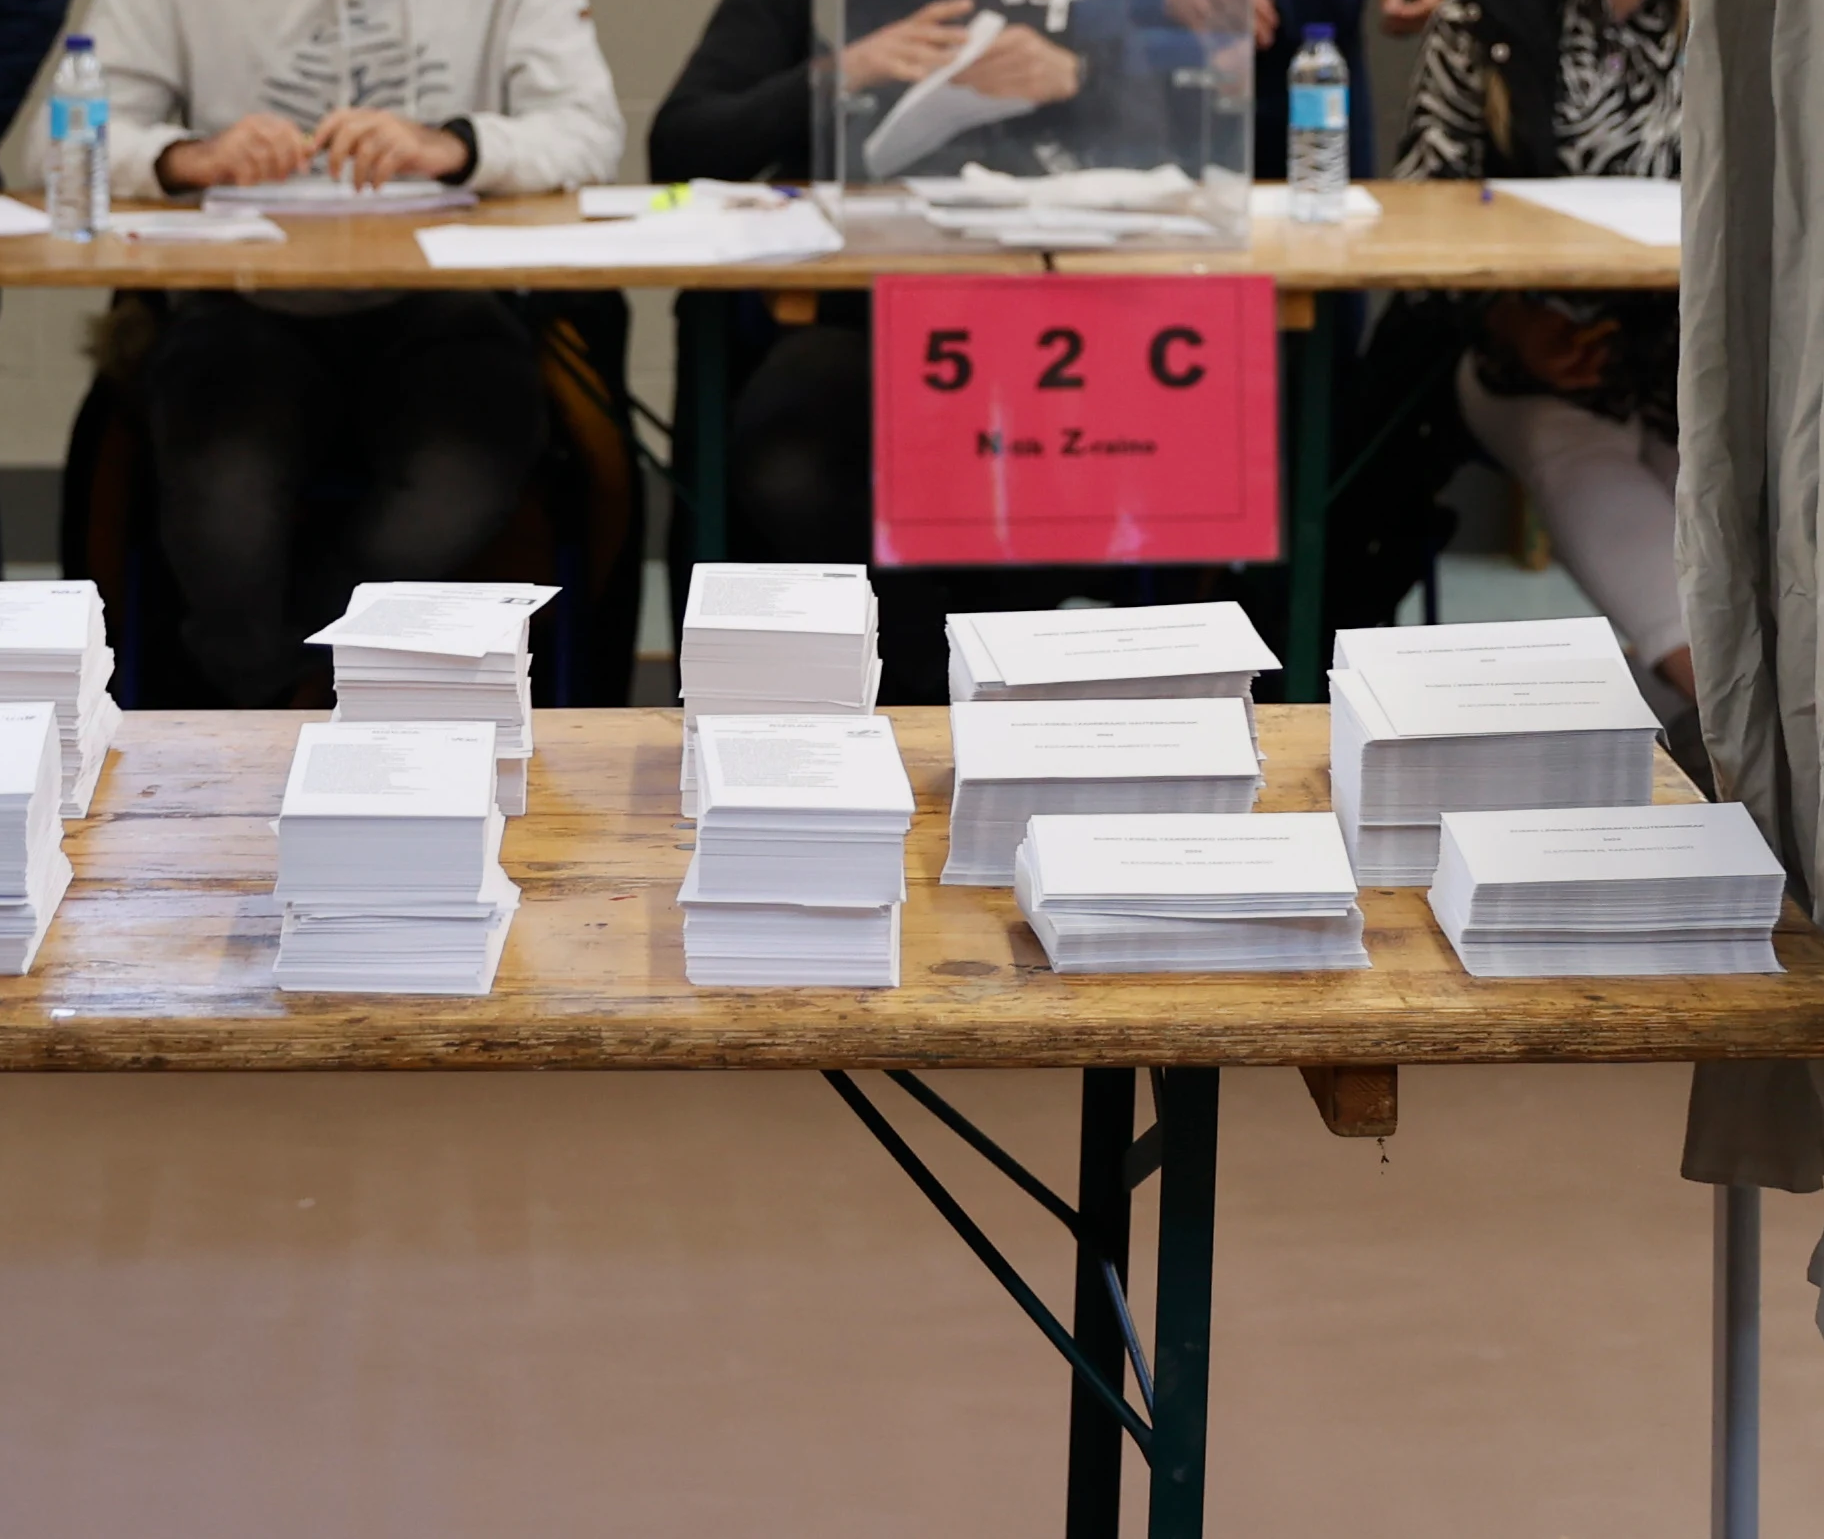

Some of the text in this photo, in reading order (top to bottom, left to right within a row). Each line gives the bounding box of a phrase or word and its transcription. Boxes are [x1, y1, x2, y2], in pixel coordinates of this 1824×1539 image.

[922, 324, 1207, 393] 5 2 C
